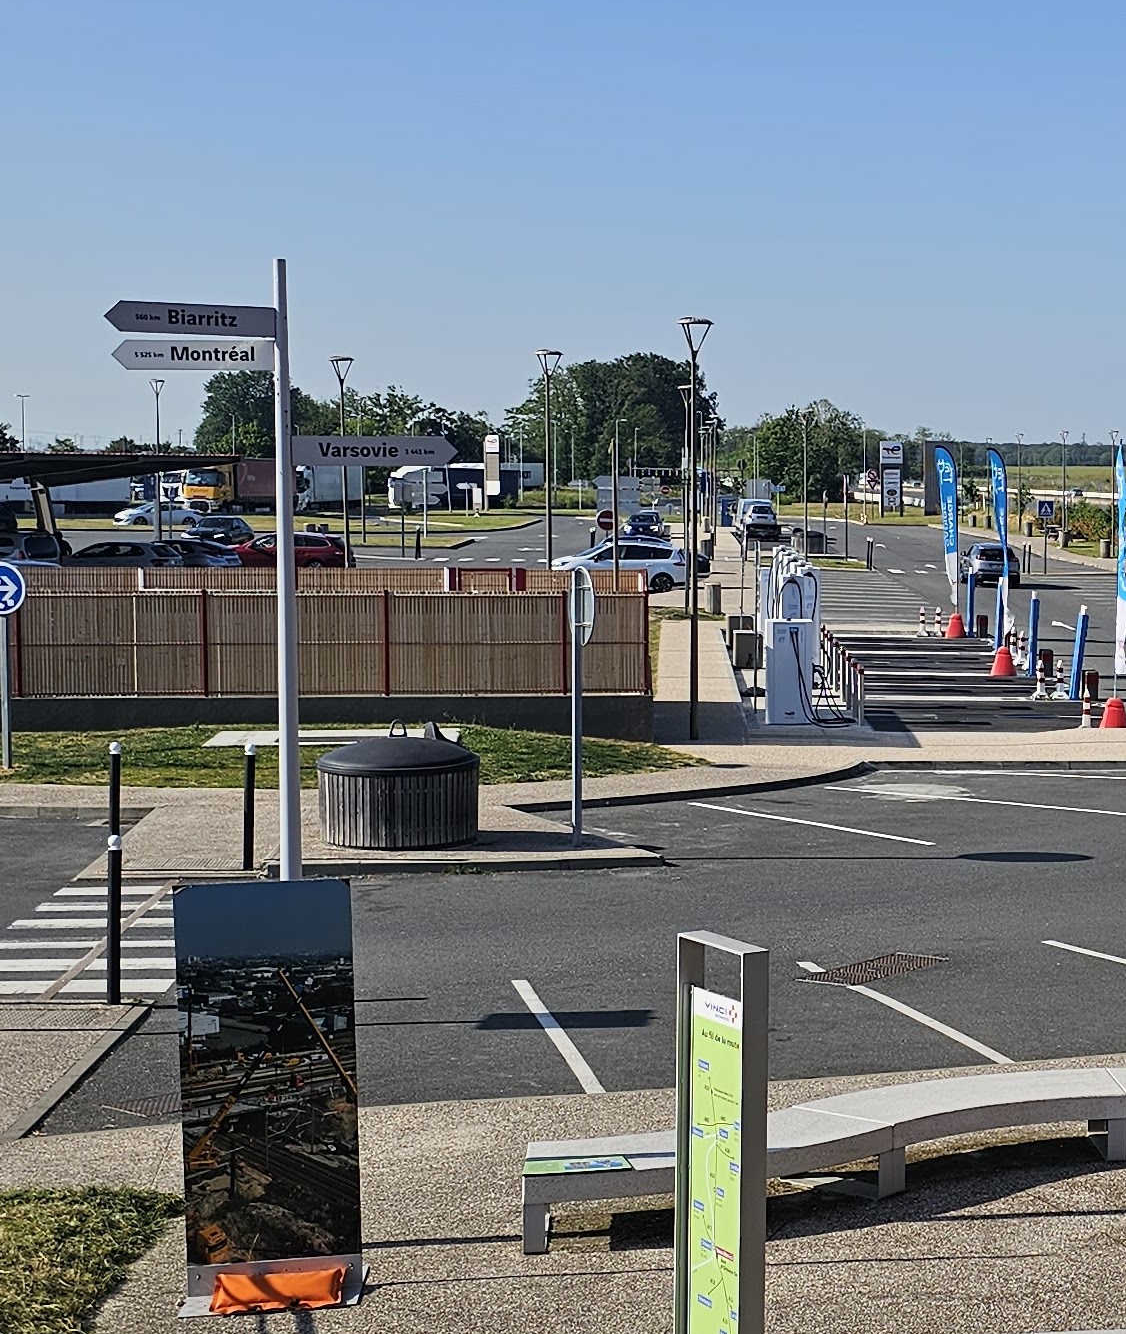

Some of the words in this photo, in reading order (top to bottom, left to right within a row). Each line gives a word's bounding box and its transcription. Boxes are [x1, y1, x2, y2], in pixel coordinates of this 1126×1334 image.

[135, 313, 149, 321] 560
[149, 313, 161, 321] km
[167, 308, 238, 328] Biarritz
[170, 345, 256, 362] Montréal
[318, 442, 399, 458] Varsovie
[705, 1001, 728, 1016] VINCI
